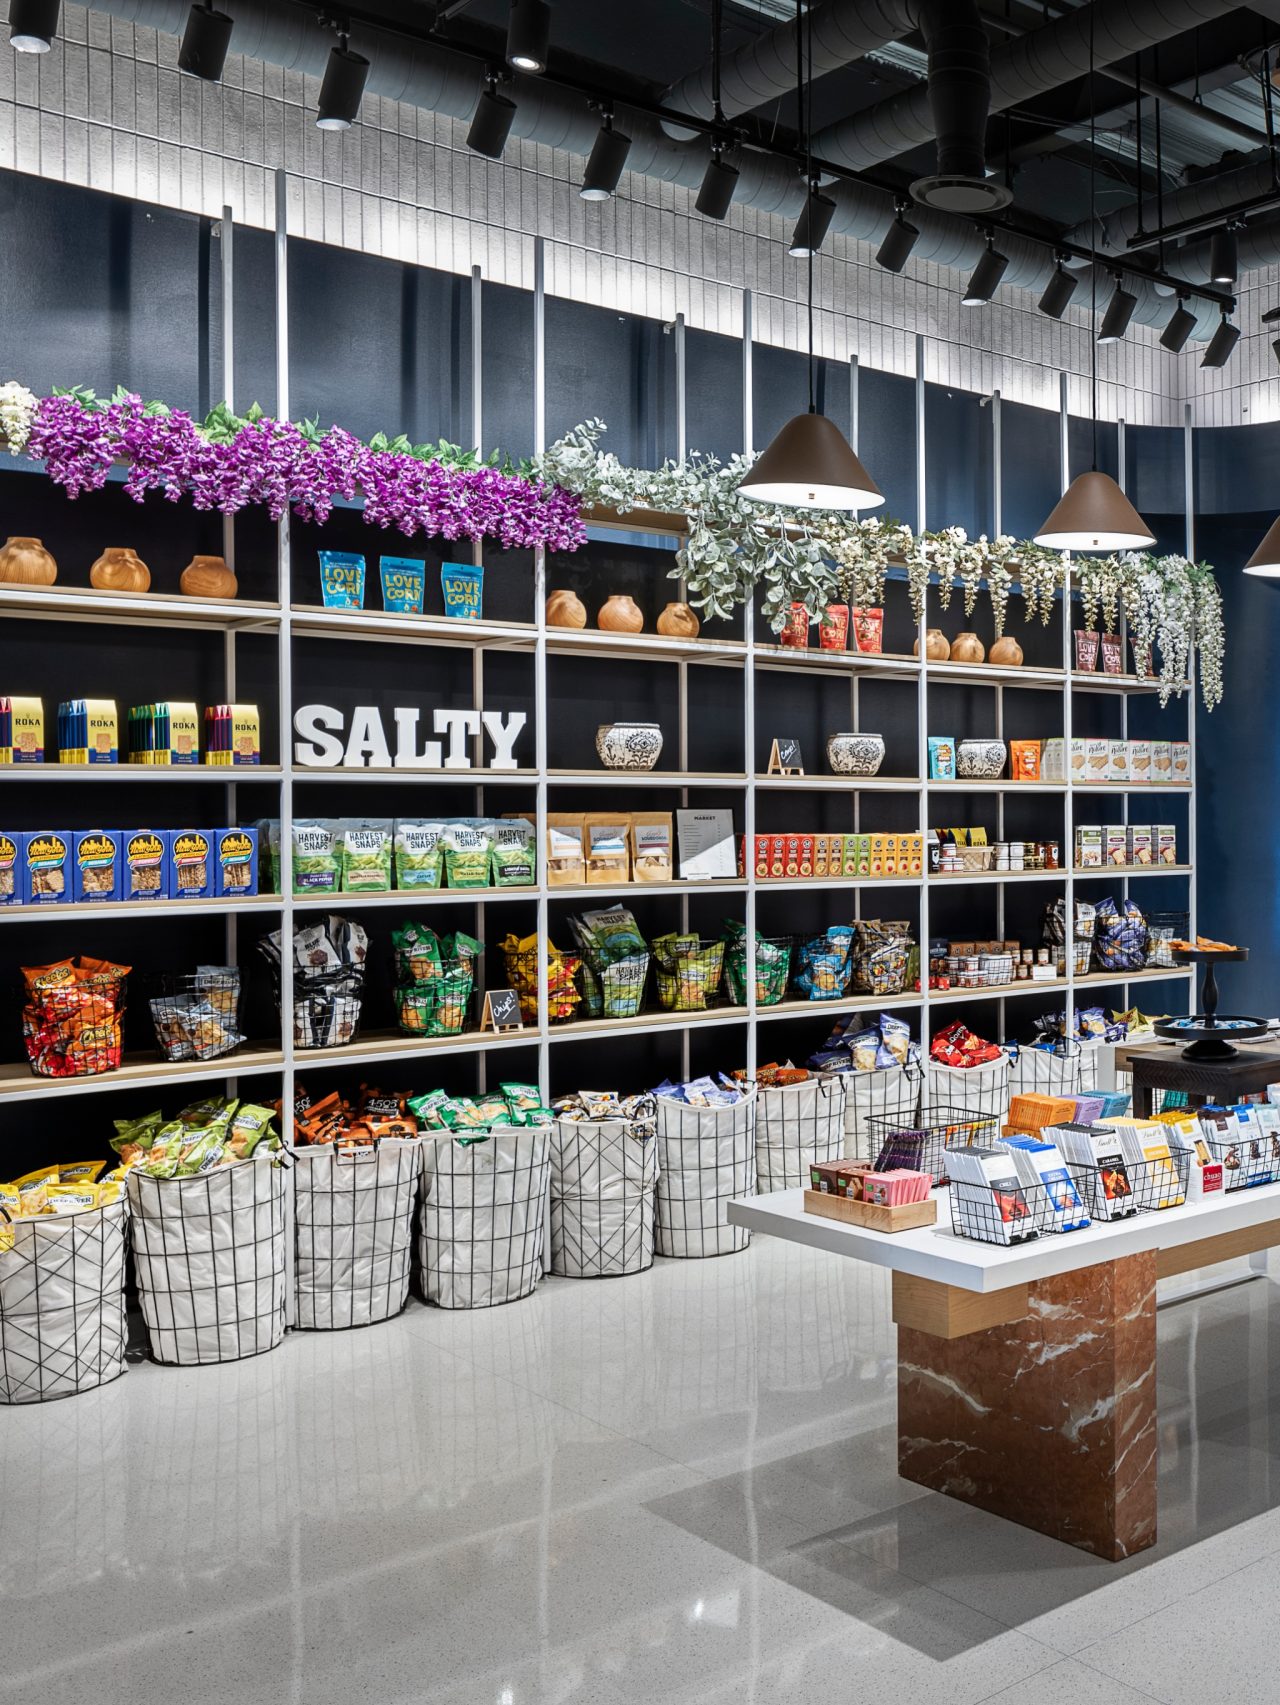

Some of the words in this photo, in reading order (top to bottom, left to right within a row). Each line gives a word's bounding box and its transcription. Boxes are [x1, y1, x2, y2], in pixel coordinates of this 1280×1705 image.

[325, 567, 361, 582] LOVE
[385, 574, 421, 589] LOVE
[445, 580, 480, 594] LOVE
[1079, 642, 1097, 653] LOVE
[15, 718, 40, 726] ROKA
[90, 719, 115, 728] ROKA
[172, 721, 196, 730] ROKA
[235, 723, 257, 732] ROKA
[293, 703, 527, 769] SALTY
[298, 833, 334, 844] HARVEST
[349, 832, 384, 841] HARVEST
[406, 832, 439, 841] HARVEST
[455, 831, 485, 839] HARVEST
[498, 829, 527, 839] HARVEST
[304, 843, 329, 851] SNAPS
[355, 840, 381, 849] SNAPS
[410, 840, 435, 849] SNAPS
[460, 839, 482, 847] SNAPS
[596, 914, 626, 923] HARVEST
[304, 938, 320, 949] BLUE
[493, 992, 516, 1018] Chips!
[949, 1025, 967, 1044] Doritos
[367, 1098, 398, 1108] 4505
[1204, 1171, 1222, 1181] chuao
